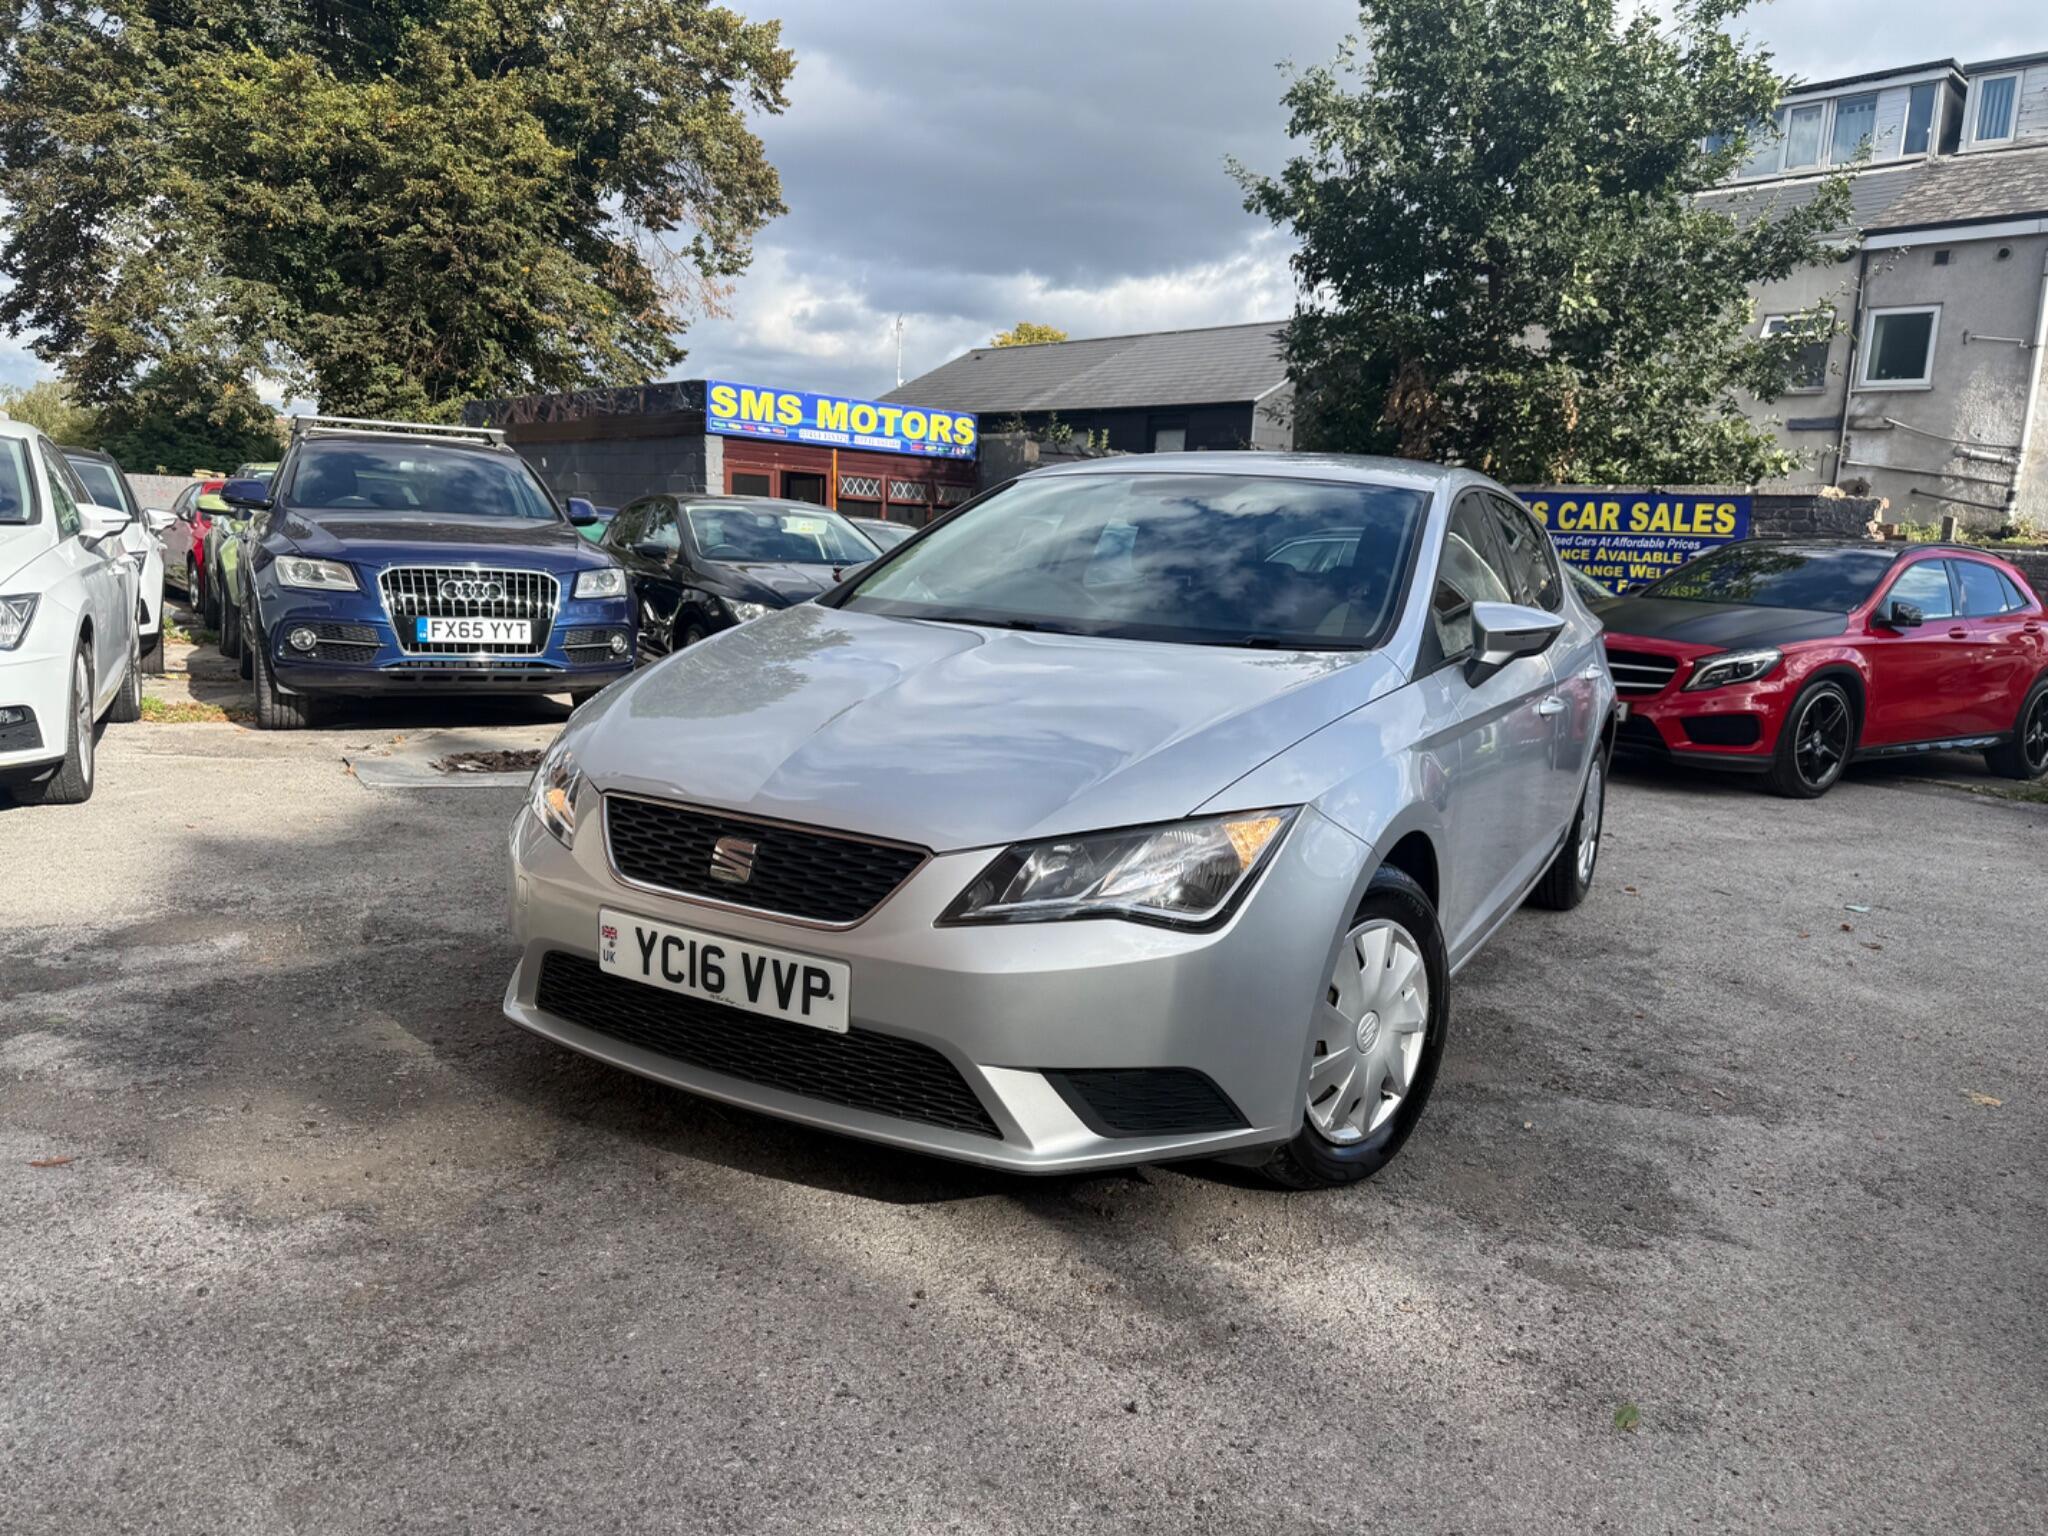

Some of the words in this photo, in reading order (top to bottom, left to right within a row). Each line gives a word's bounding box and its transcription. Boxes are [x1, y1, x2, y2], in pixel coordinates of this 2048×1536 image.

[710, 385, 803, 426] SMS
[816, 399, 975, 445] MOTORS
[1557, 501, 1621, 531] CAR
[1628, 502, 1737, 534] SALES
[1575, 535, 1598, 547] Cars
[1598, 536, 1612, 548] At
[1612, 536, 1666, 549] Affordable
[1667, 538, 1701, 550] Prices
[1559, 548, 1590, 561] NCE
[1594, 547, 1683, 564] AVAILABLE
[1579, 564, 1624, 578] ANGE
[431, 620, 484, 638] FX65
[489, 622, 527, 639] YYT
[602, 949, 616, 965] UK
[635, 926, 725, 994] YC16
[741, 951, 831, 1017] VVP
